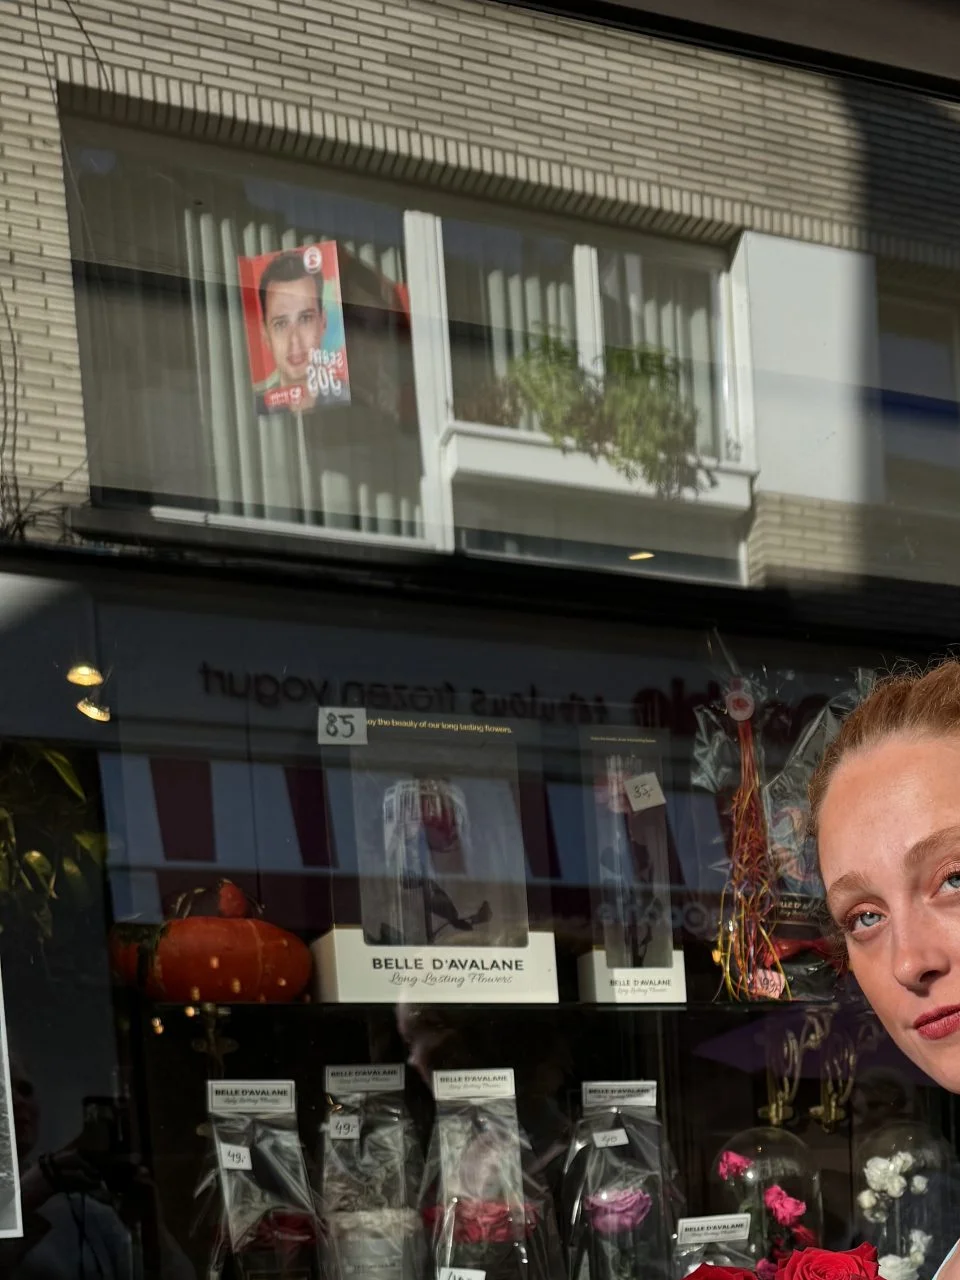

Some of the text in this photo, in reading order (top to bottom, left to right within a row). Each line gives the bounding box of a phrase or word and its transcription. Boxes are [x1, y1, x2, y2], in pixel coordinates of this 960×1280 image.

[325, 712, 355, 738] 85
[372, 958, 524, 972] BELLE D'AVALANE
[389, 971, 512, 988] Long Lasting Flowers
[609, 979, 631, 987] BELLE
